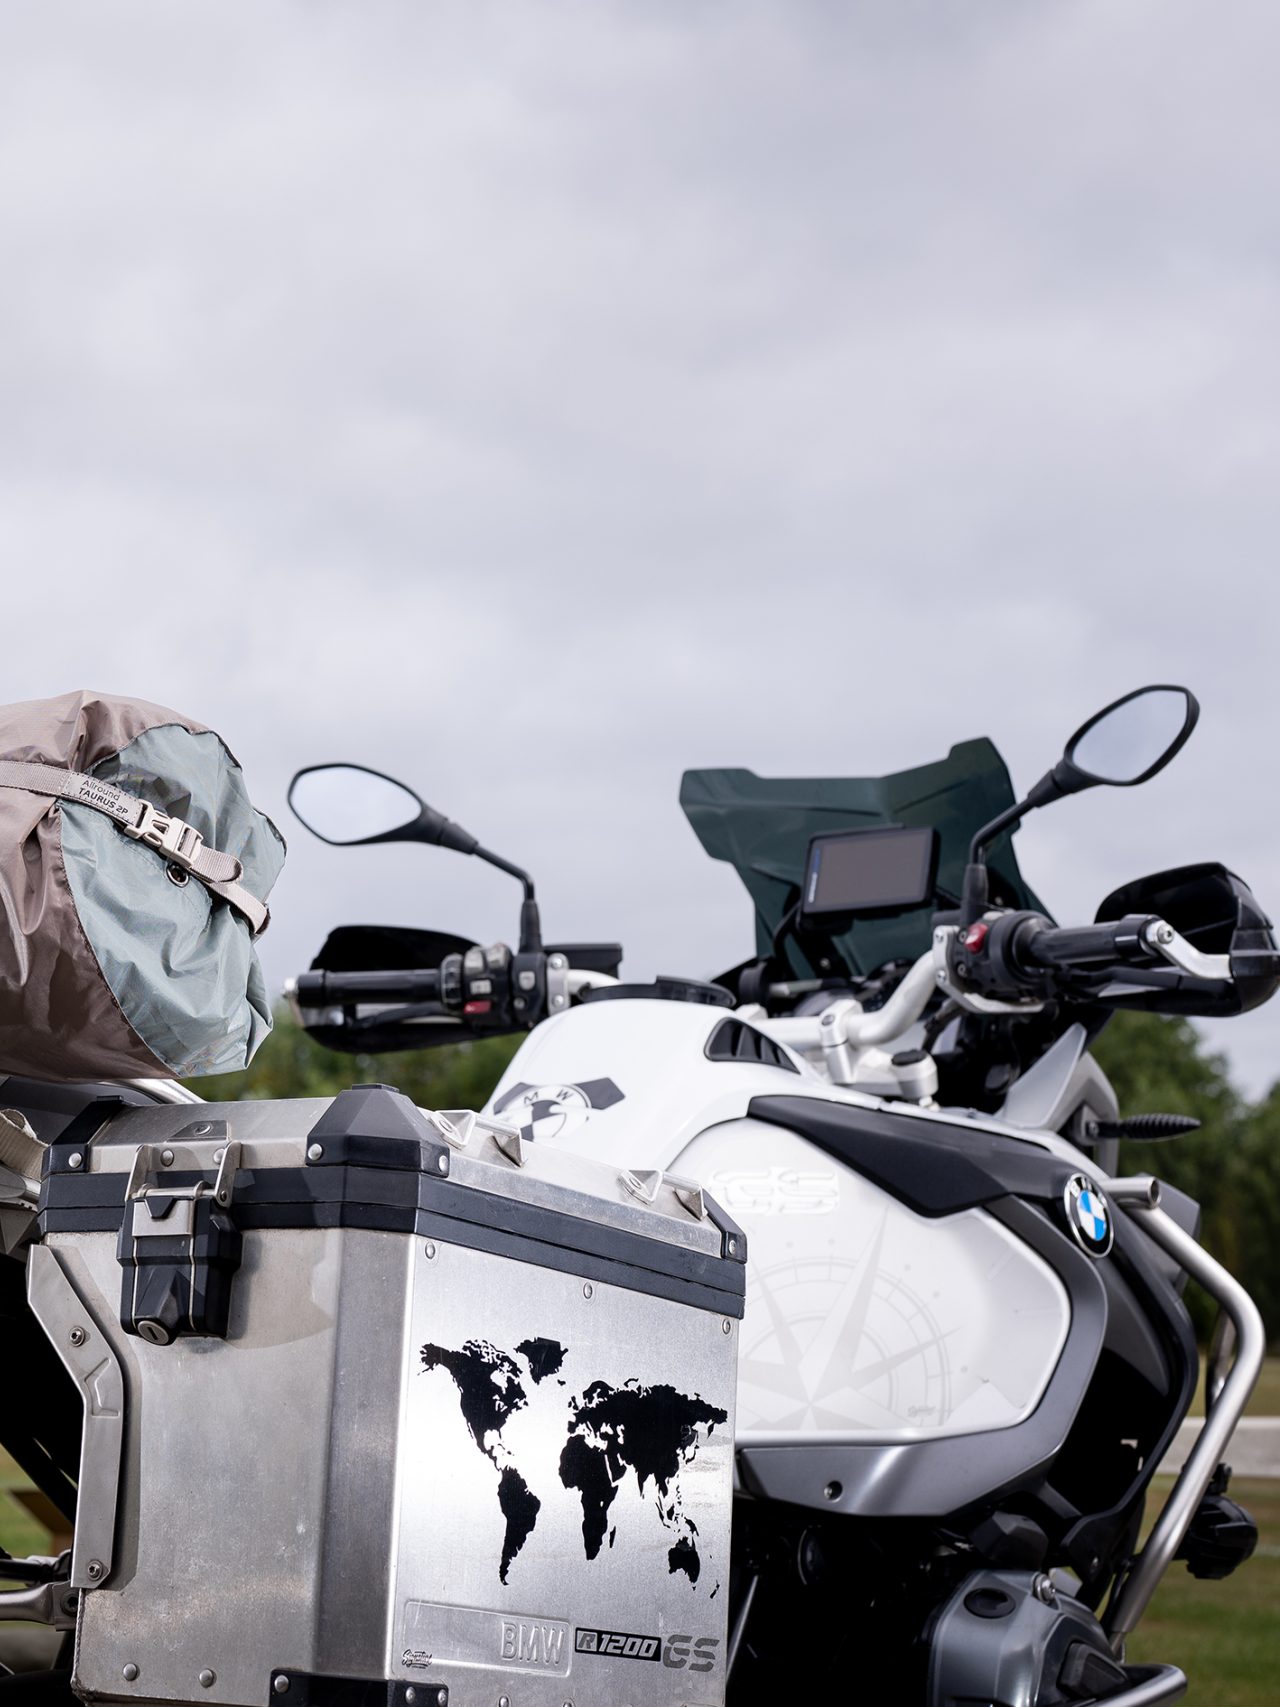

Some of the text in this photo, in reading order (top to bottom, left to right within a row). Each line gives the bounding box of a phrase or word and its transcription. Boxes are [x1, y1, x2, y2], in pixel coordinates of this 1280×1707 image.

[78, 788, 129, 815] TAURUS 2P
[82, 780, 121, 801] Allround
[501, 1621, 566, 1666] BMW
